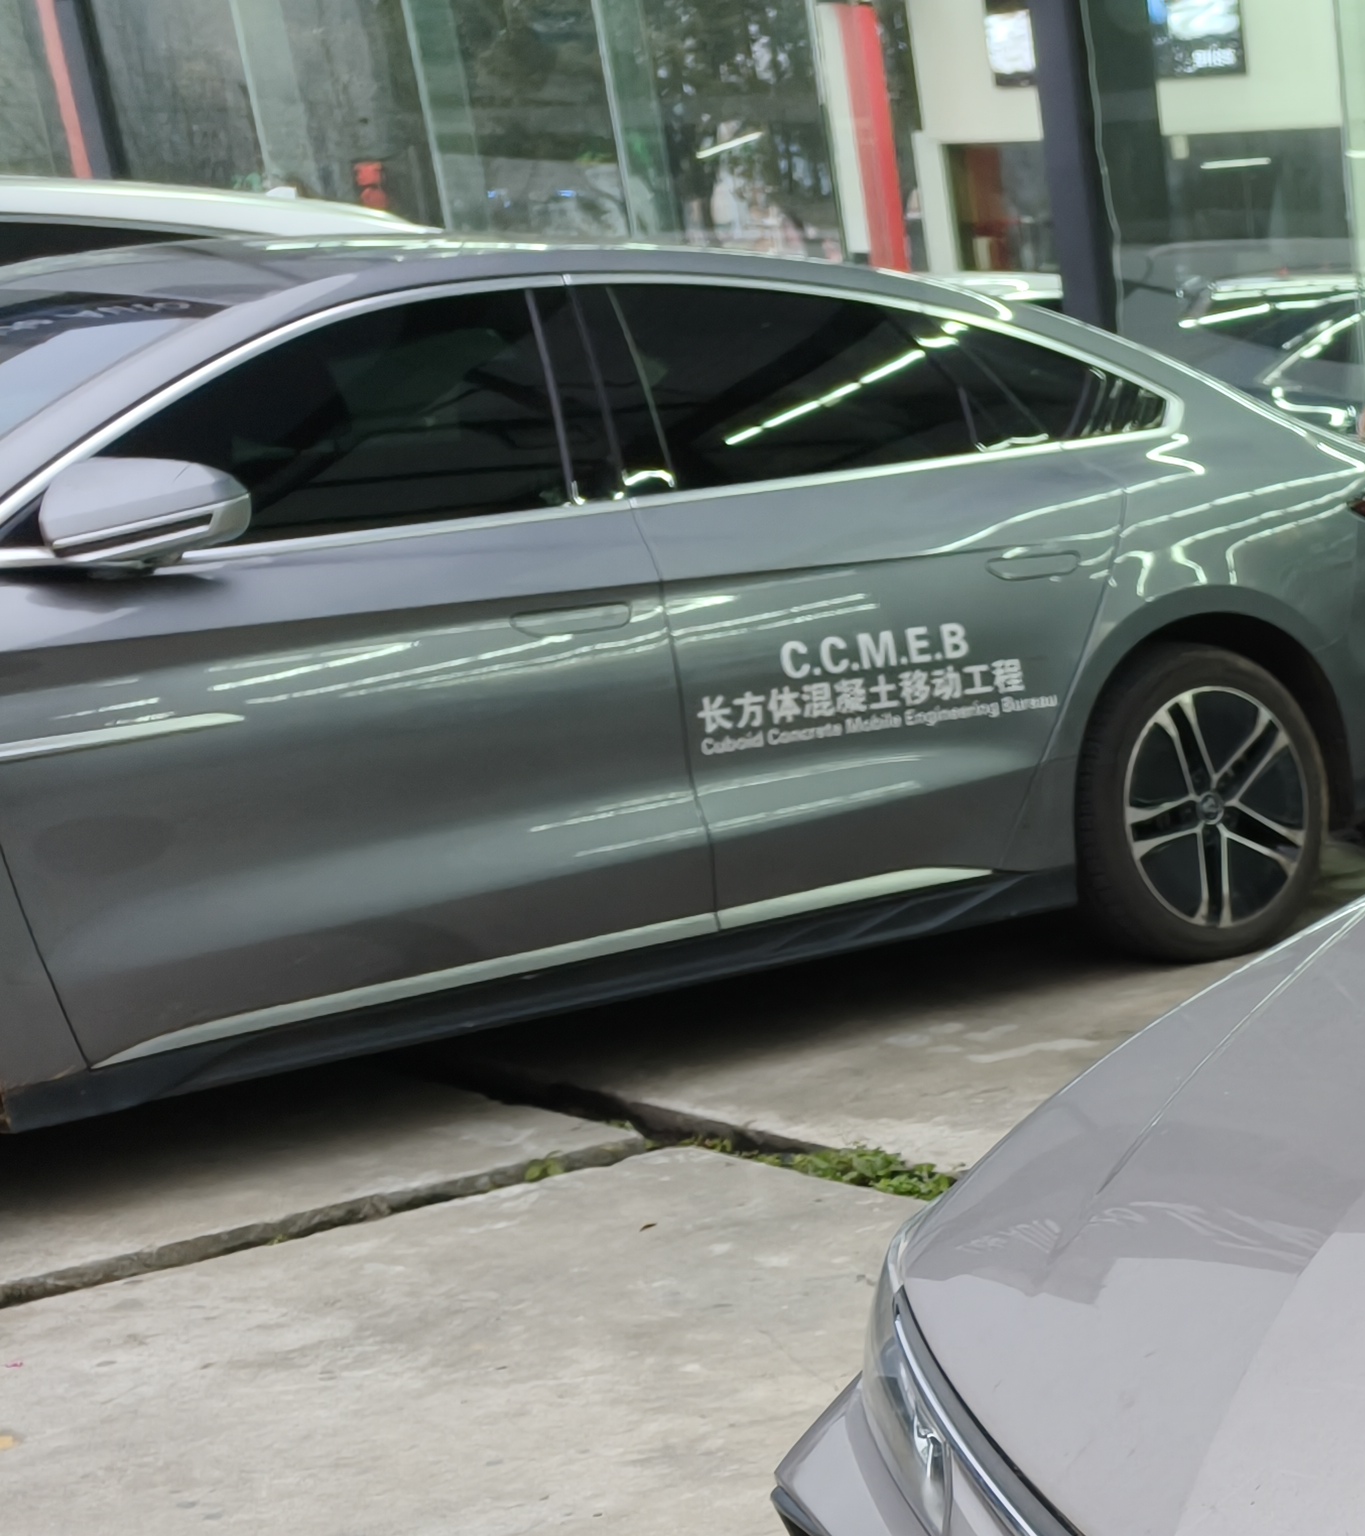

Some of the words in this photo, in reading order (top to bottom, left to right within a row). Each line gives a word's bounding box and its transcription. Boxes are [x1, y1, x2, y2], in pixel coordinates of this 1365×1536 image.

[780, 622, 970, 679] C.C.M.E.B
[697, 658, 1026, 733] 长方体混凝土移动工程
[701, 730, 764, 755] Cuboid
[767, 722, 843, 745] Concrete
[845, 711, 902, 734] Mobile
[904, 700, 999, 727] Engineering
[1001, 694, 1058, 713] Bureau
